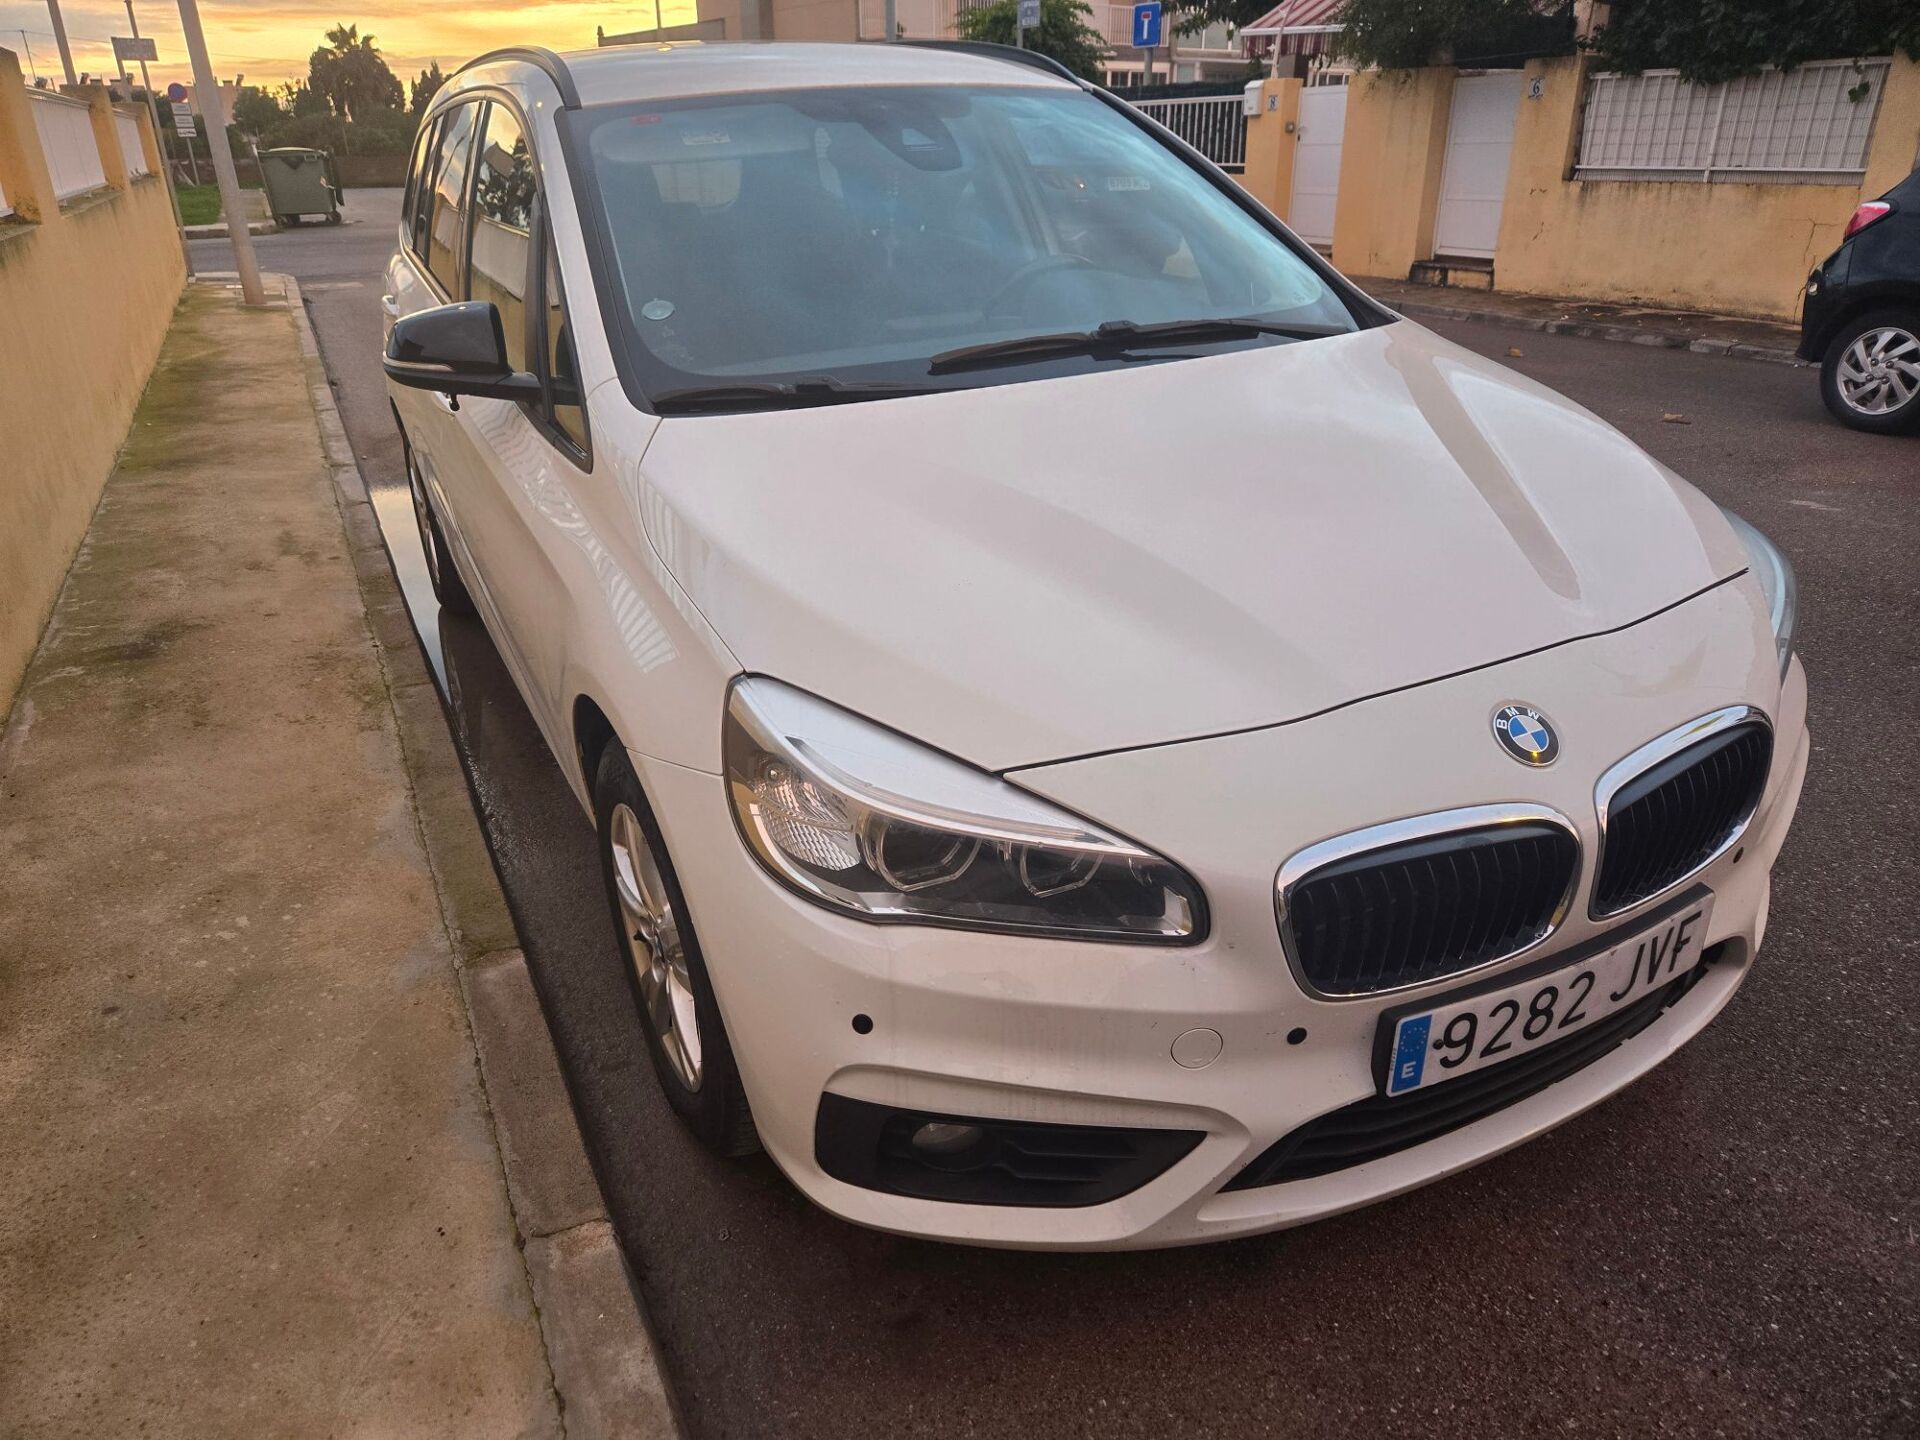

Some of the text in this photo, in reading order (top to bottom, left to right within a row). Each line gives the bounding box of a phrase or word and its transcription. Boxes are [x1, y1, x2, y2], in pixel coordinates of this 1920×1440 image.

[1496, 706, 1541, 730] BMW
[1440, 910, 1702, 1069] 9282 JVF
[1401, 1061, 1417, 1079] E
